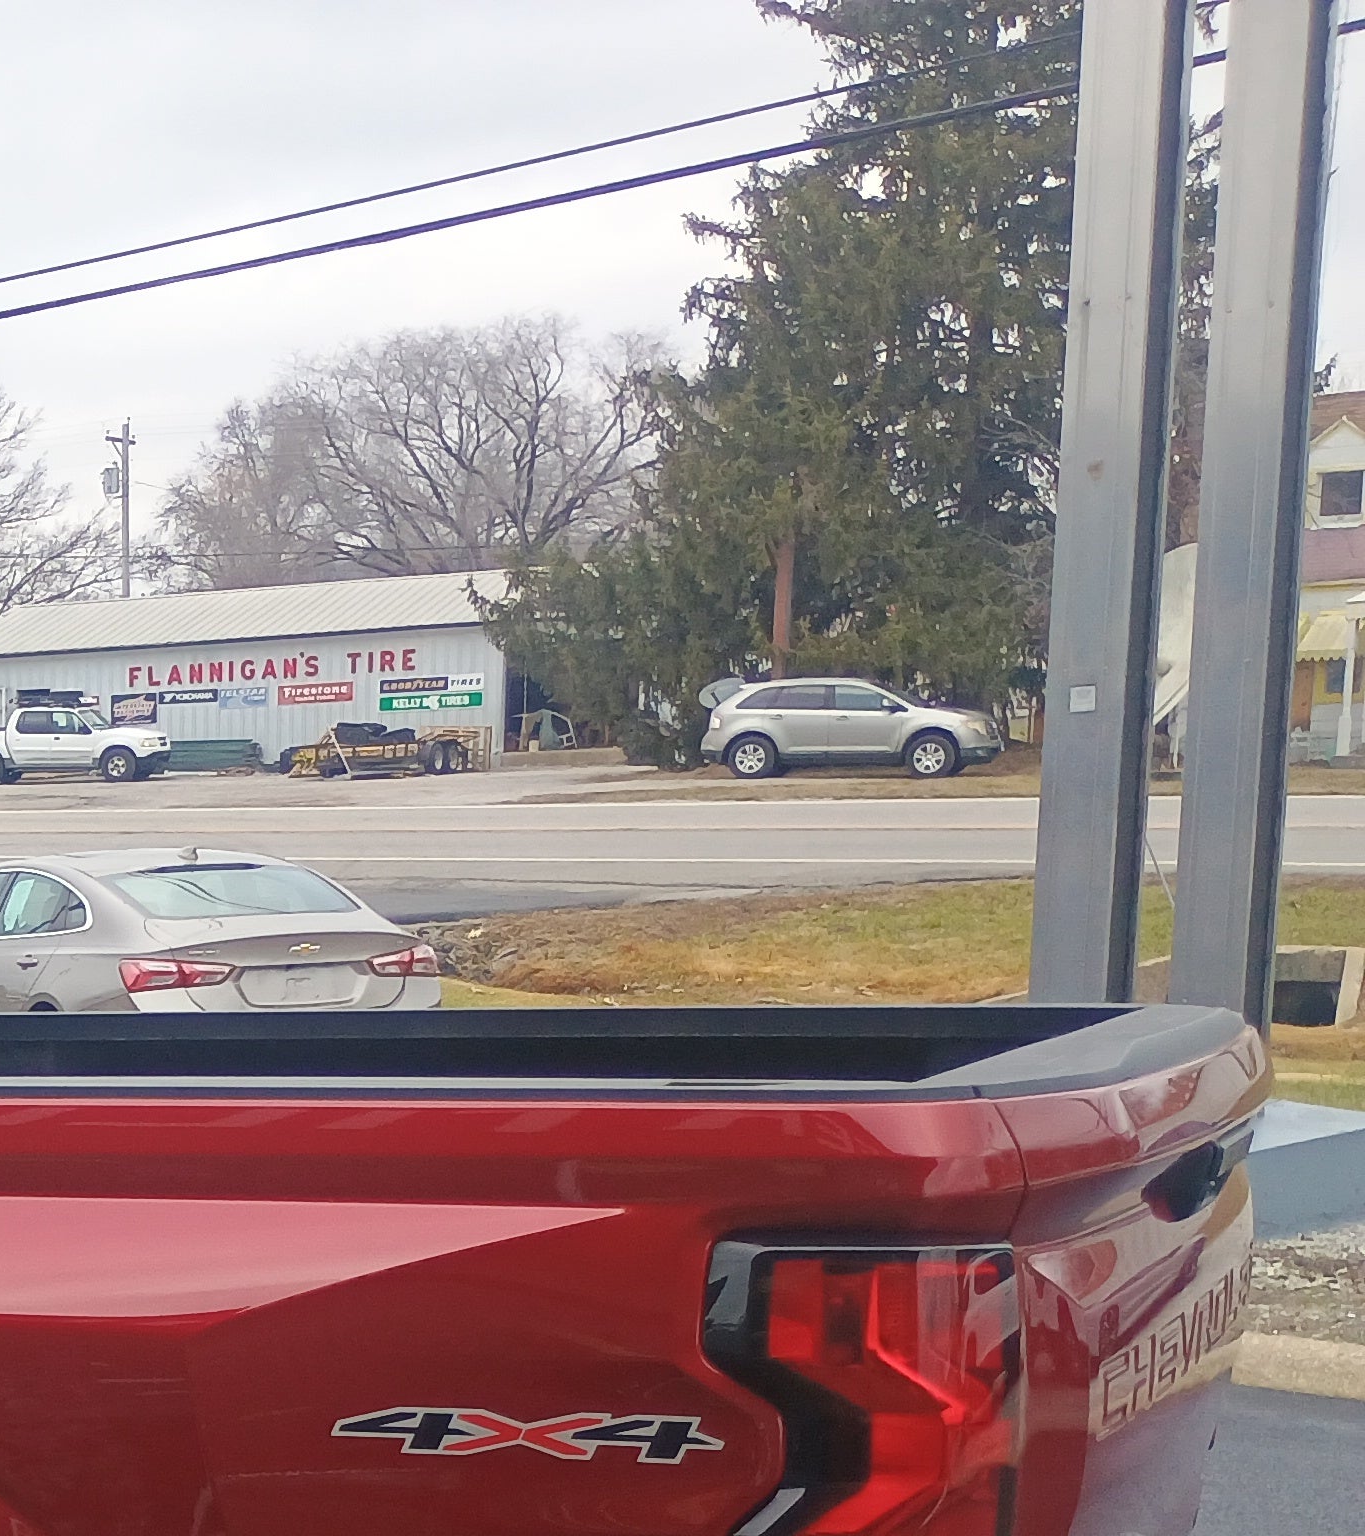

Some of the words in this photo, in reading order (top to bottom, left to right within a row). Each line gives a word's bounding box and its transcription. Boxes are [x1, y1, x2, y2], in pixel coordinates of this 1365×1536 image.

[128, 651, 320, 688] FLANNIGAN'S
[347, 648, 417, 674] TIRE
[450, 677, 482, 687] TIRES
[392, 698, 421, 709] KELLY
